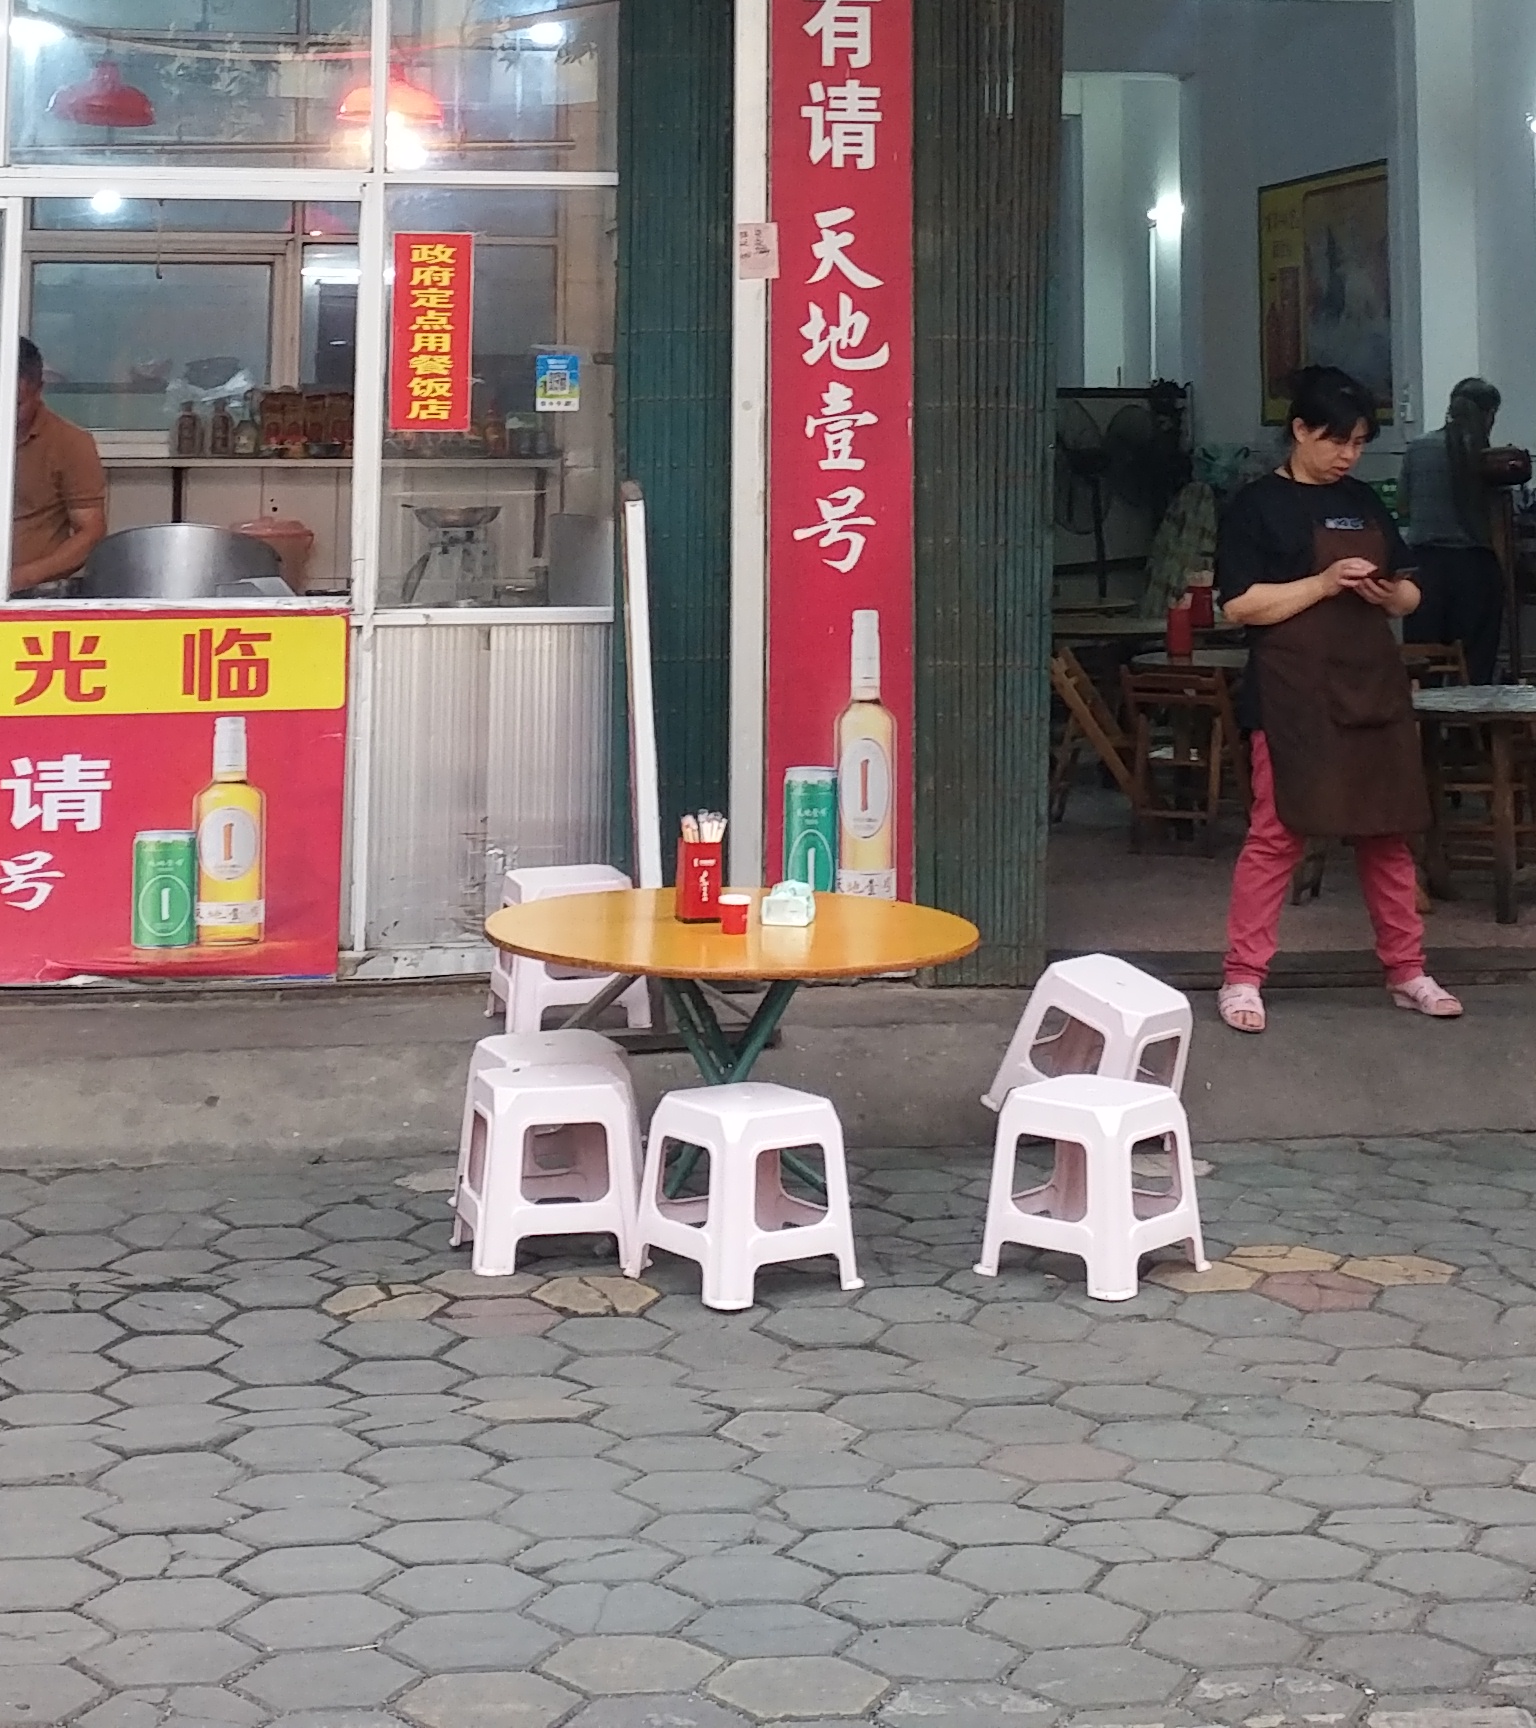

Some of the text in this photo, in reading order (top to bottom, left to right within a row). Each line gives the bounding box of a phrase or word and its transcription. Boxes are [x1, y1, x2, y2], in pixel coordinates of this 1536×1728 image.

[405, 242, 457, 422] 政府定点用餐饭店
[793, 206, 889, 574] 天地壹号
